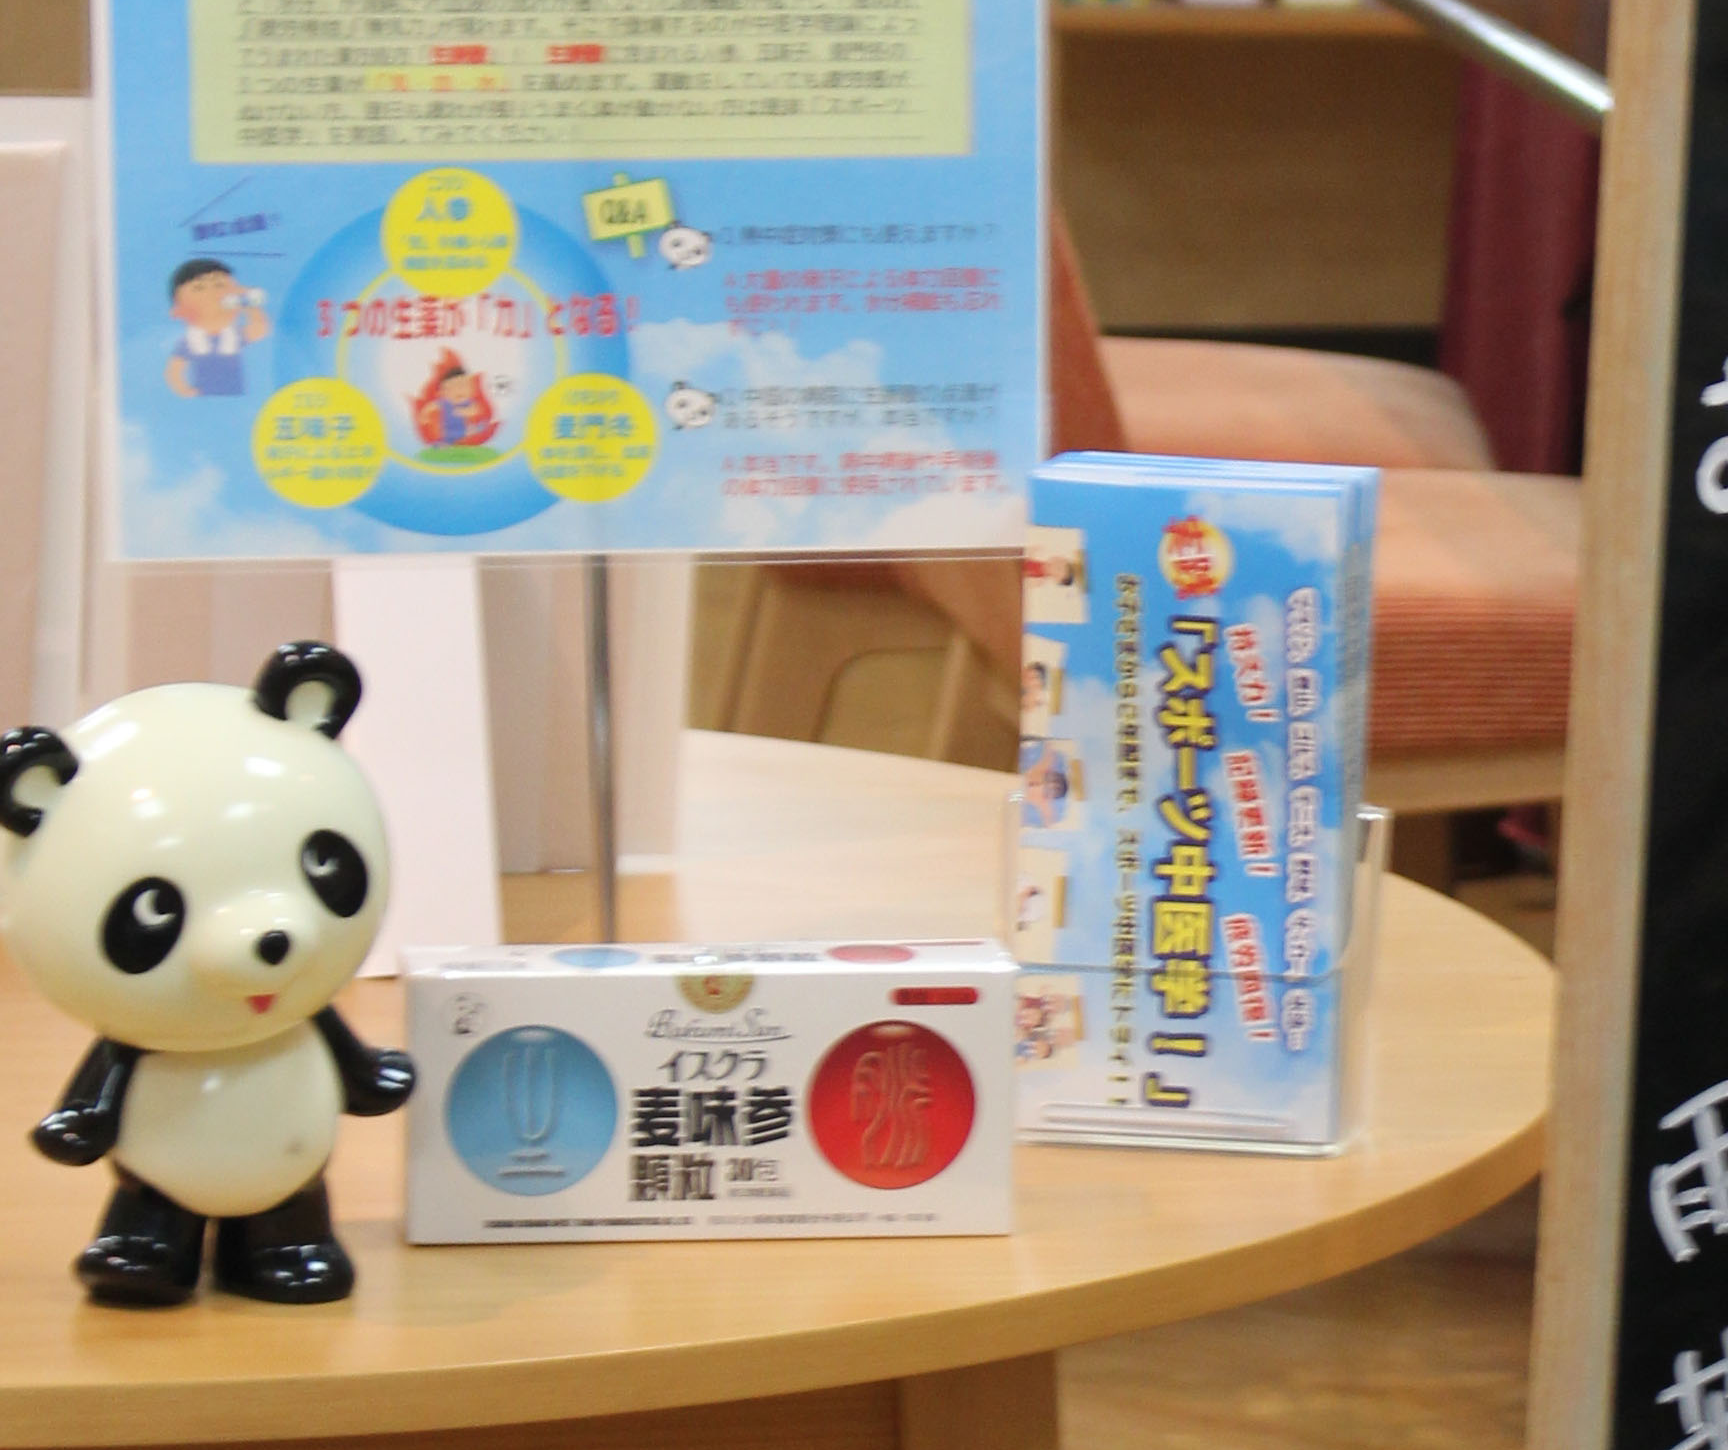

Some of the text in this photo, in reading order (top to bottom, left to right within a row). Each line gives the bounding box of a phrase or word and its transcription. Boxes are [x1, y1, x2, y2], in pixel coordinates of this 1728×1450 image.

[1143, 615, 1219, 1107] 「スポーツ中医学！」
[657, 1049, 767, 1083] イスクラ
